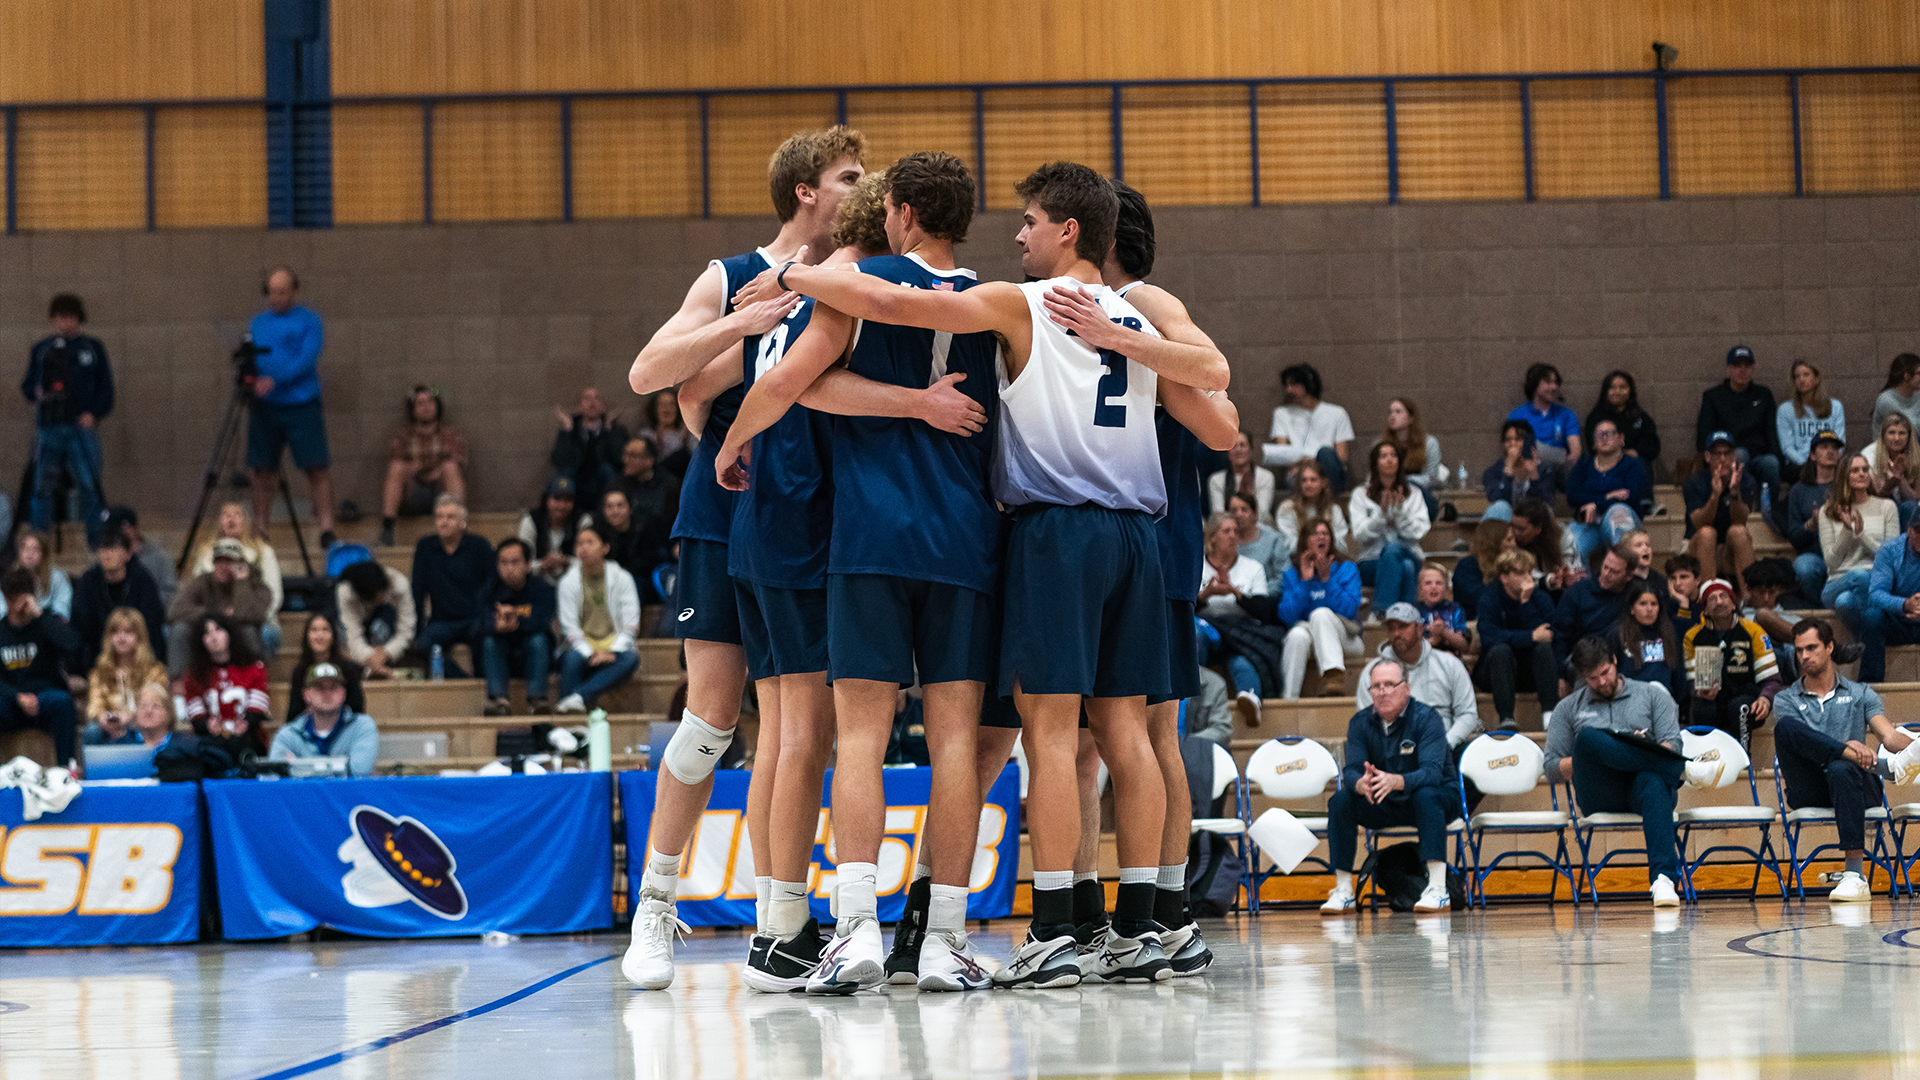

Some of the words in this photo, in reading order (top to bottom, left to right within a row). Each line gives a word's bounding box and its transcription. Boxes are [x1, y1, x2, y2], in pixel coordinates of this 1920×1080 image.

[1093, 346, 1128, 428] 2
[1488, 754, 1519, 770] UCSB
[1694, 748, 1720, 763] CSB
[1276, 758, 1308, 775] UCSB
[0, 822, 184, 917] SB
